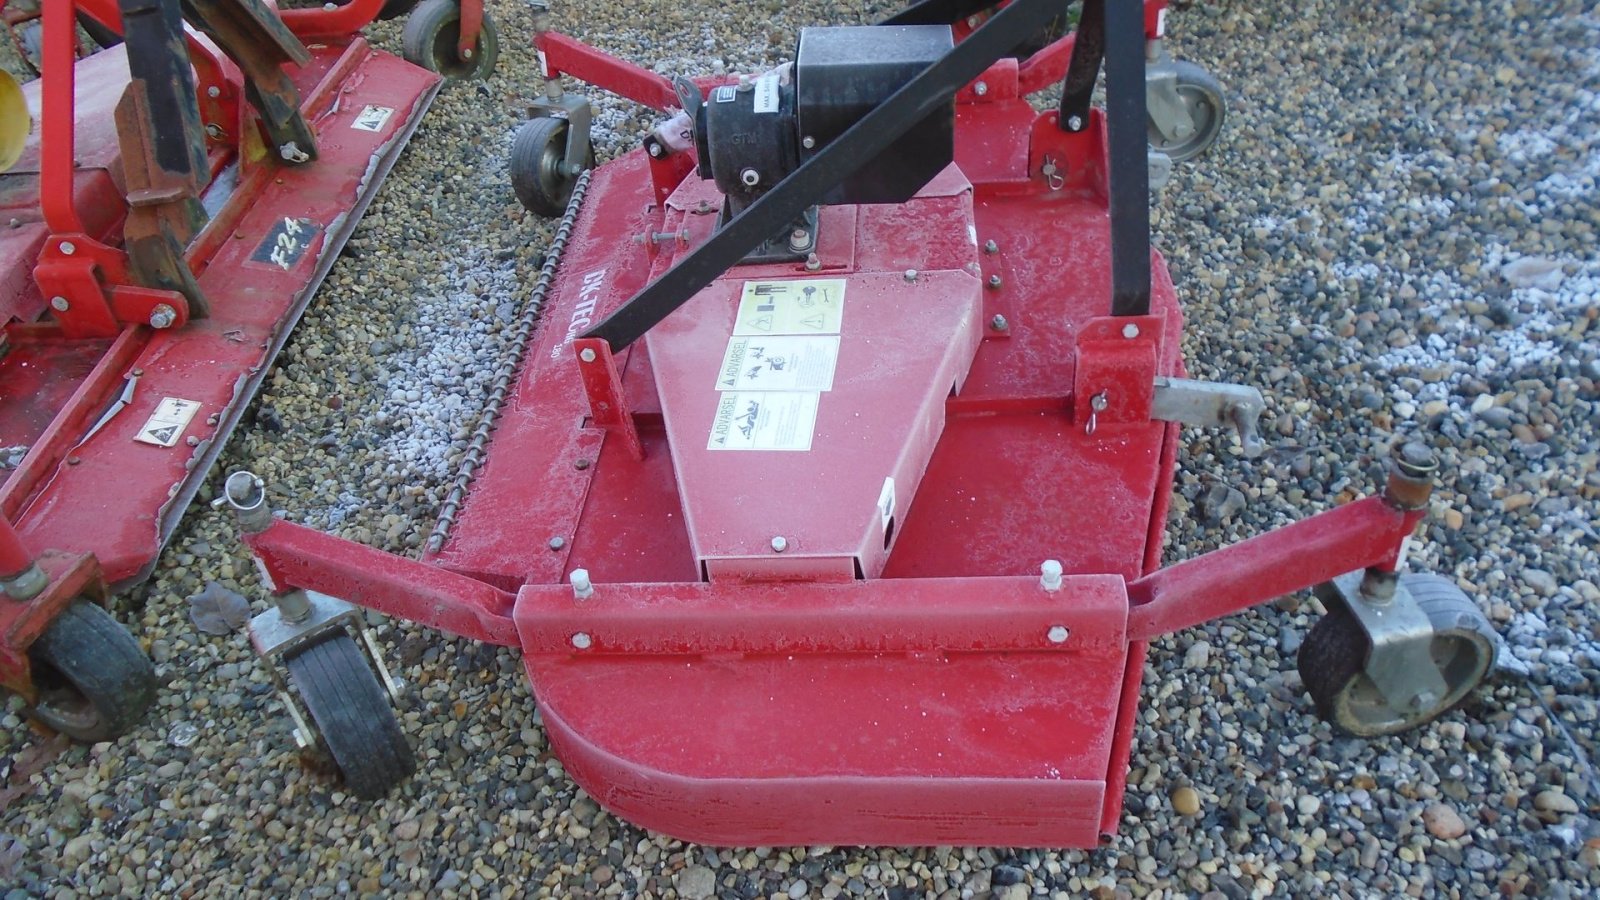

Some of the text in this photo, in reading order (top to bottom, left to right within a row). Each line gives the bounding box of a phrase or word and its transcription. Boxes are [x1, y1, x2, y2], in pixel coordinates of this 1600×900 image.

[271, 217, 303, 271] F24
[568, 269, 607, 331] DK-TEC
[726, 340, 747, 379] ADVARSEL
[715, 395, 737, 434] ADVARSEL
